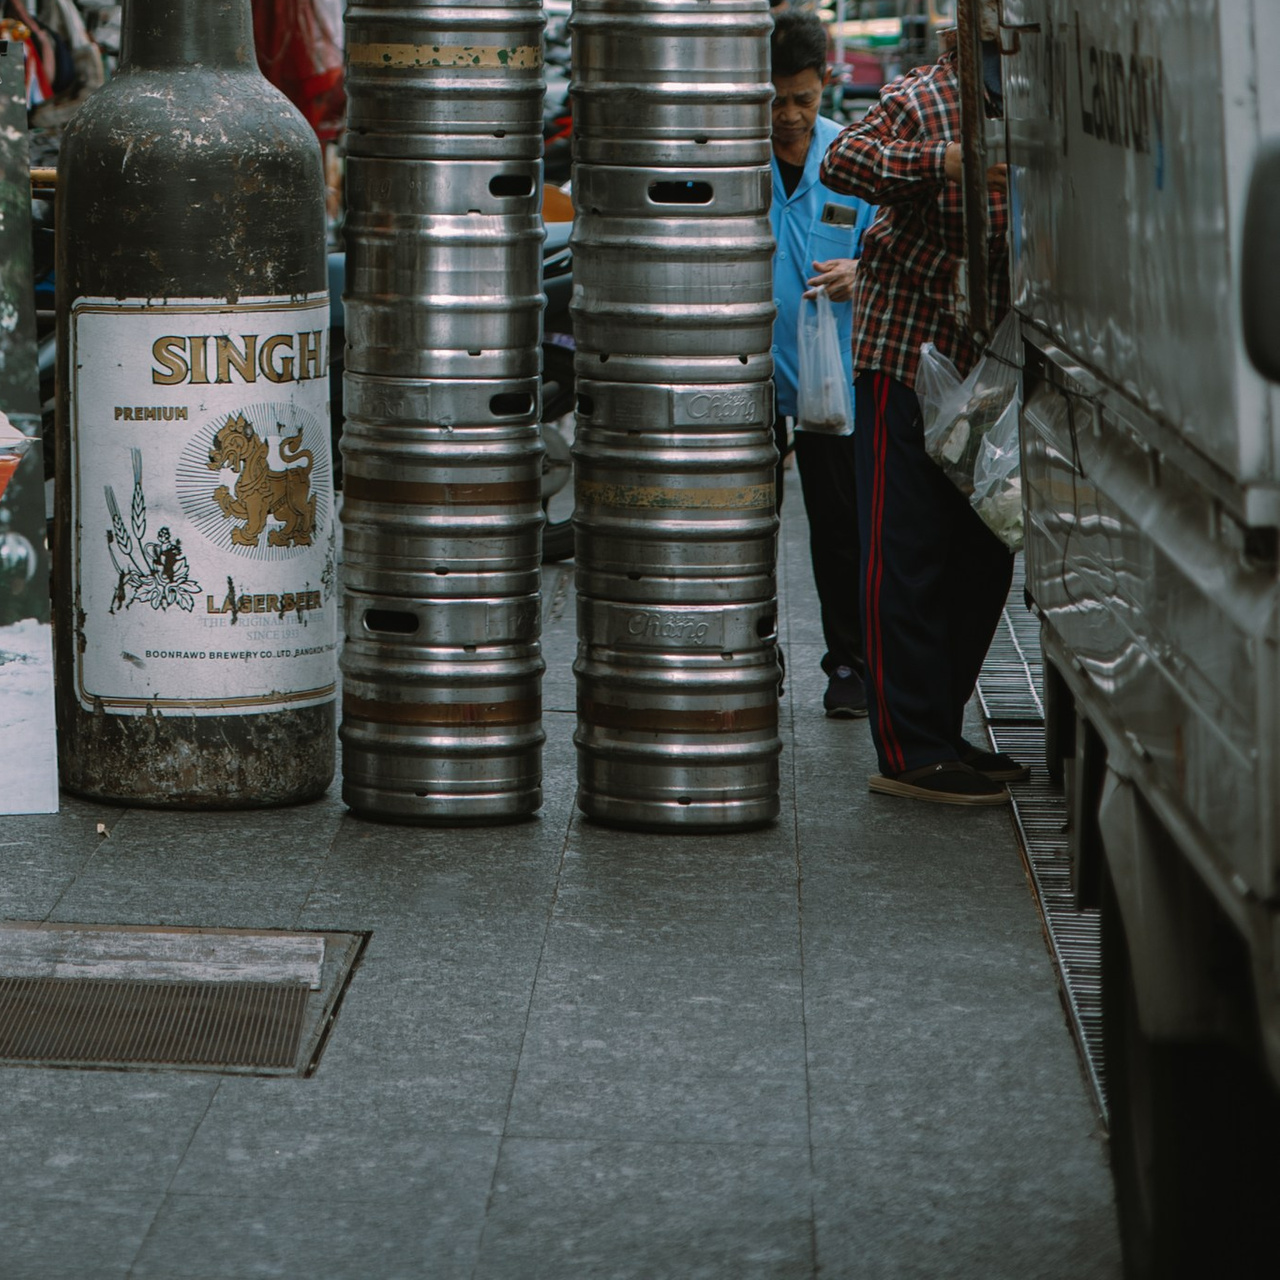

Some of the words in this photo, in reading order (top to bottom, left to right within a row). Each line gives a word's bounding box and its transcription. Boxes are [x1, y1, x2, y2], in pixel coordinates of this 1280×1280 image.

[152, 330, 327, 385] SINGH
[114, 406, 189, 422] PREMIUM
[206, 593, 281, 615] LAGER
[230, 615, 284, 628] RIGINAL
[246, 630, 280, 641] SINCE
[145, 649, 207, 660] BOONRAWD
[209, 650, 260, 660] BREWERY
